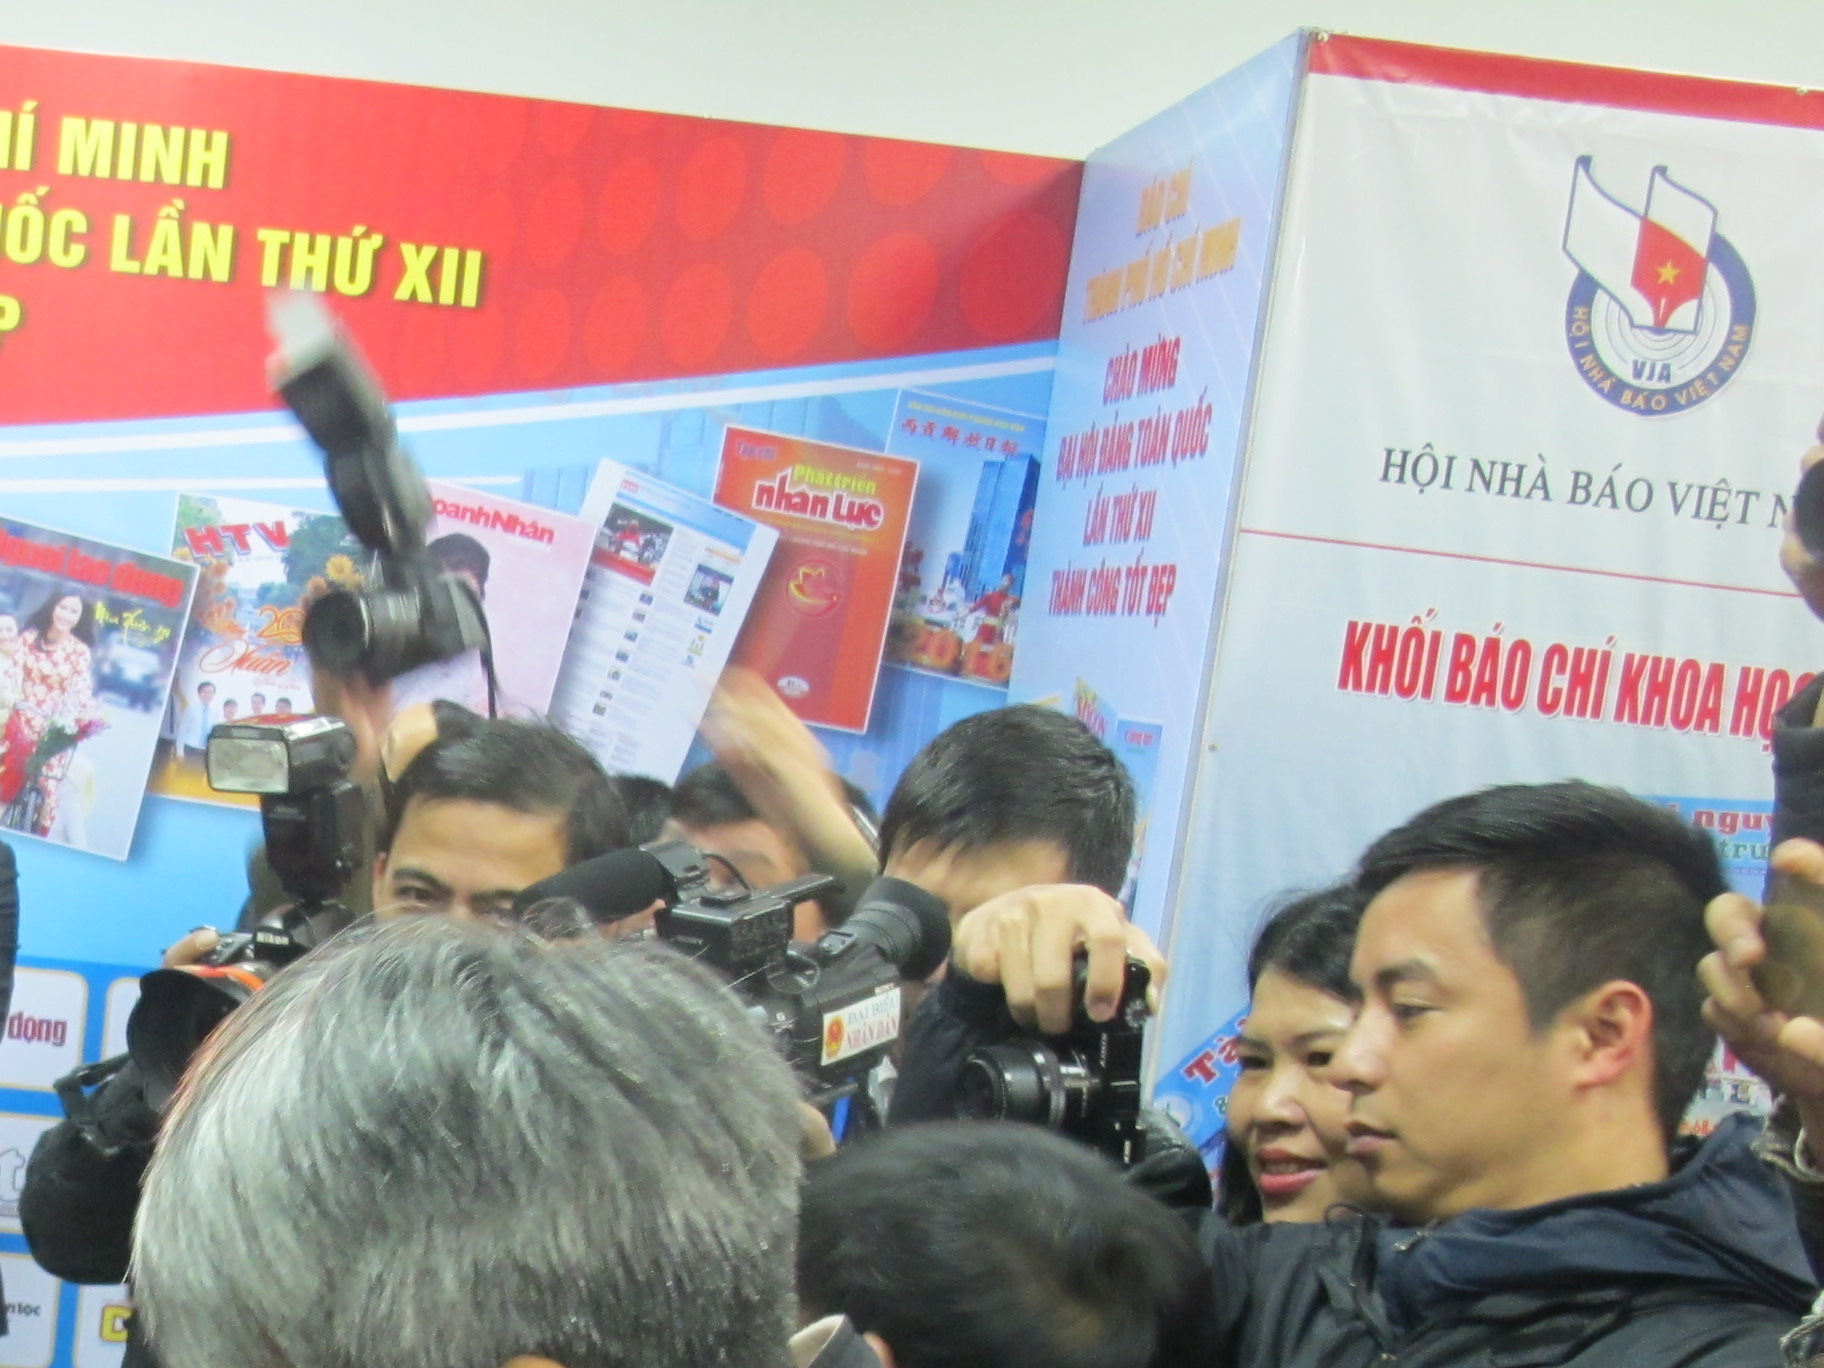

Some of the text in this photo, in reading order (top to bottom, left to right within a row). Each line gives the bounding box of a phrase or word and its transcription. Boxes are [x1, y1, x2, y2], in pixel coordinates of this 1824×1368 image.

[58, 117, 230, 190] MINH
[110, 199, 234, 282] LẦN
[258, 225, 383, 297] THỨ
[393, 244, 483, 307] XII
[1571, 306, 1590, 348] HỘI
[1620, 391, 1666, 410] BÁO
[1675, 372, 1719, 405] VIỆT
[1719, 325, 1748, 371] NAM
[433, 499, 555, 544] oanhNhân
[1380, 442, 1456, 494] HỘI
[1465, 453, 1552, 501] NHÀ
[1567, 463, 1654, 512] BÁO
[1666, 478, 1759, 530] VIỆT
[183, 521, 291, 558] HTV
[1337, 608, 1443, 702] KHỐI
[1444, 623, 1533, 712] BÁO
[1537, 636, 1616, 721] CHÍ
[1613, 653, 1725, 734] KHOA
